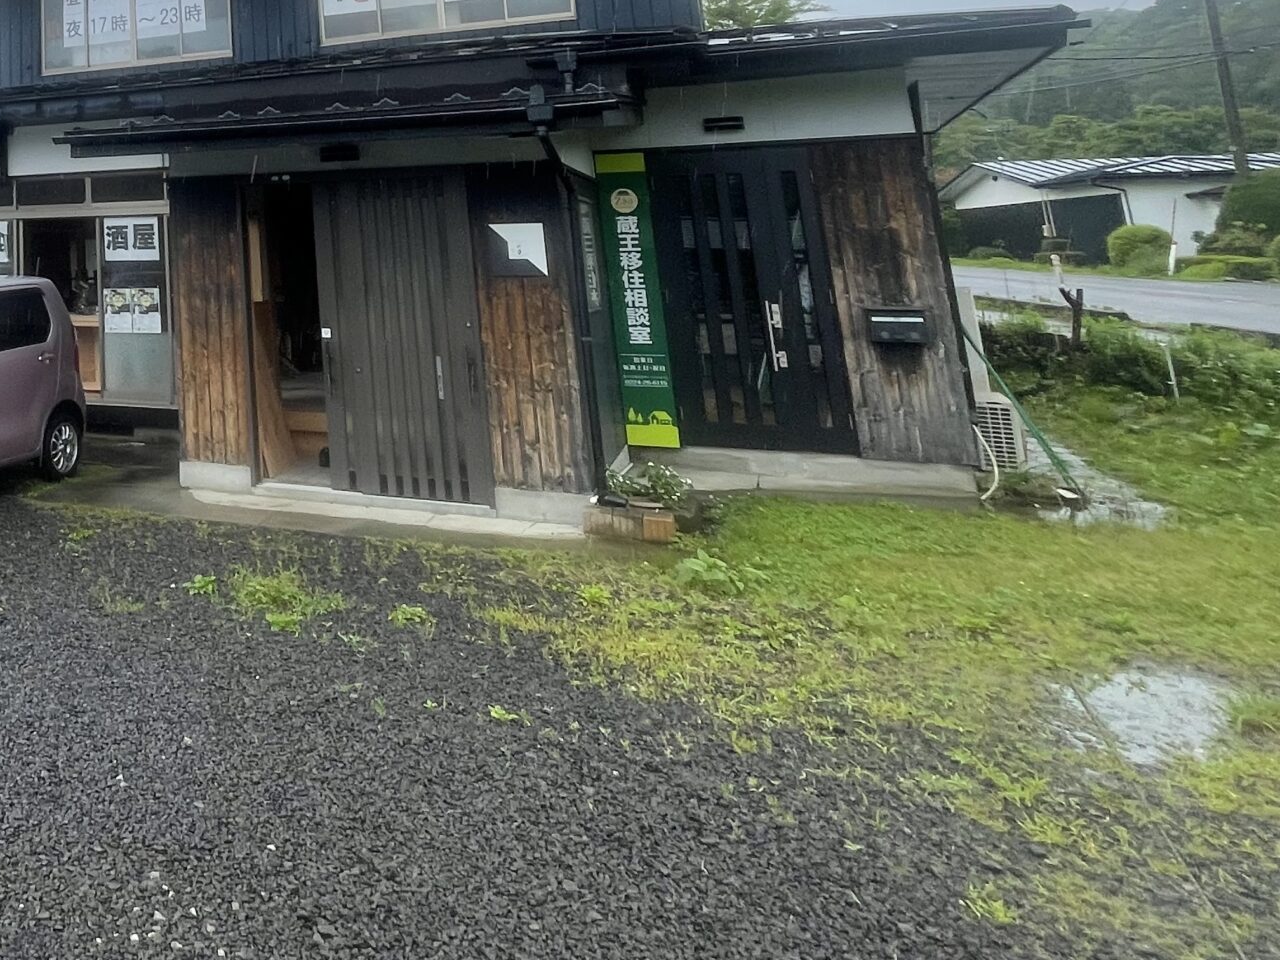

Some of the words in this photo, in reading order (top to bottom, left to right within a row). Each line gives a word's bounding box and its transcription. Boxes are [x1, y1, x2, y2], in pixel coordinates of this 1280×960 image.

[105, 223, 156, 251] 酒屋
[615, 214, 653, 345] 蔵王移住相談室
